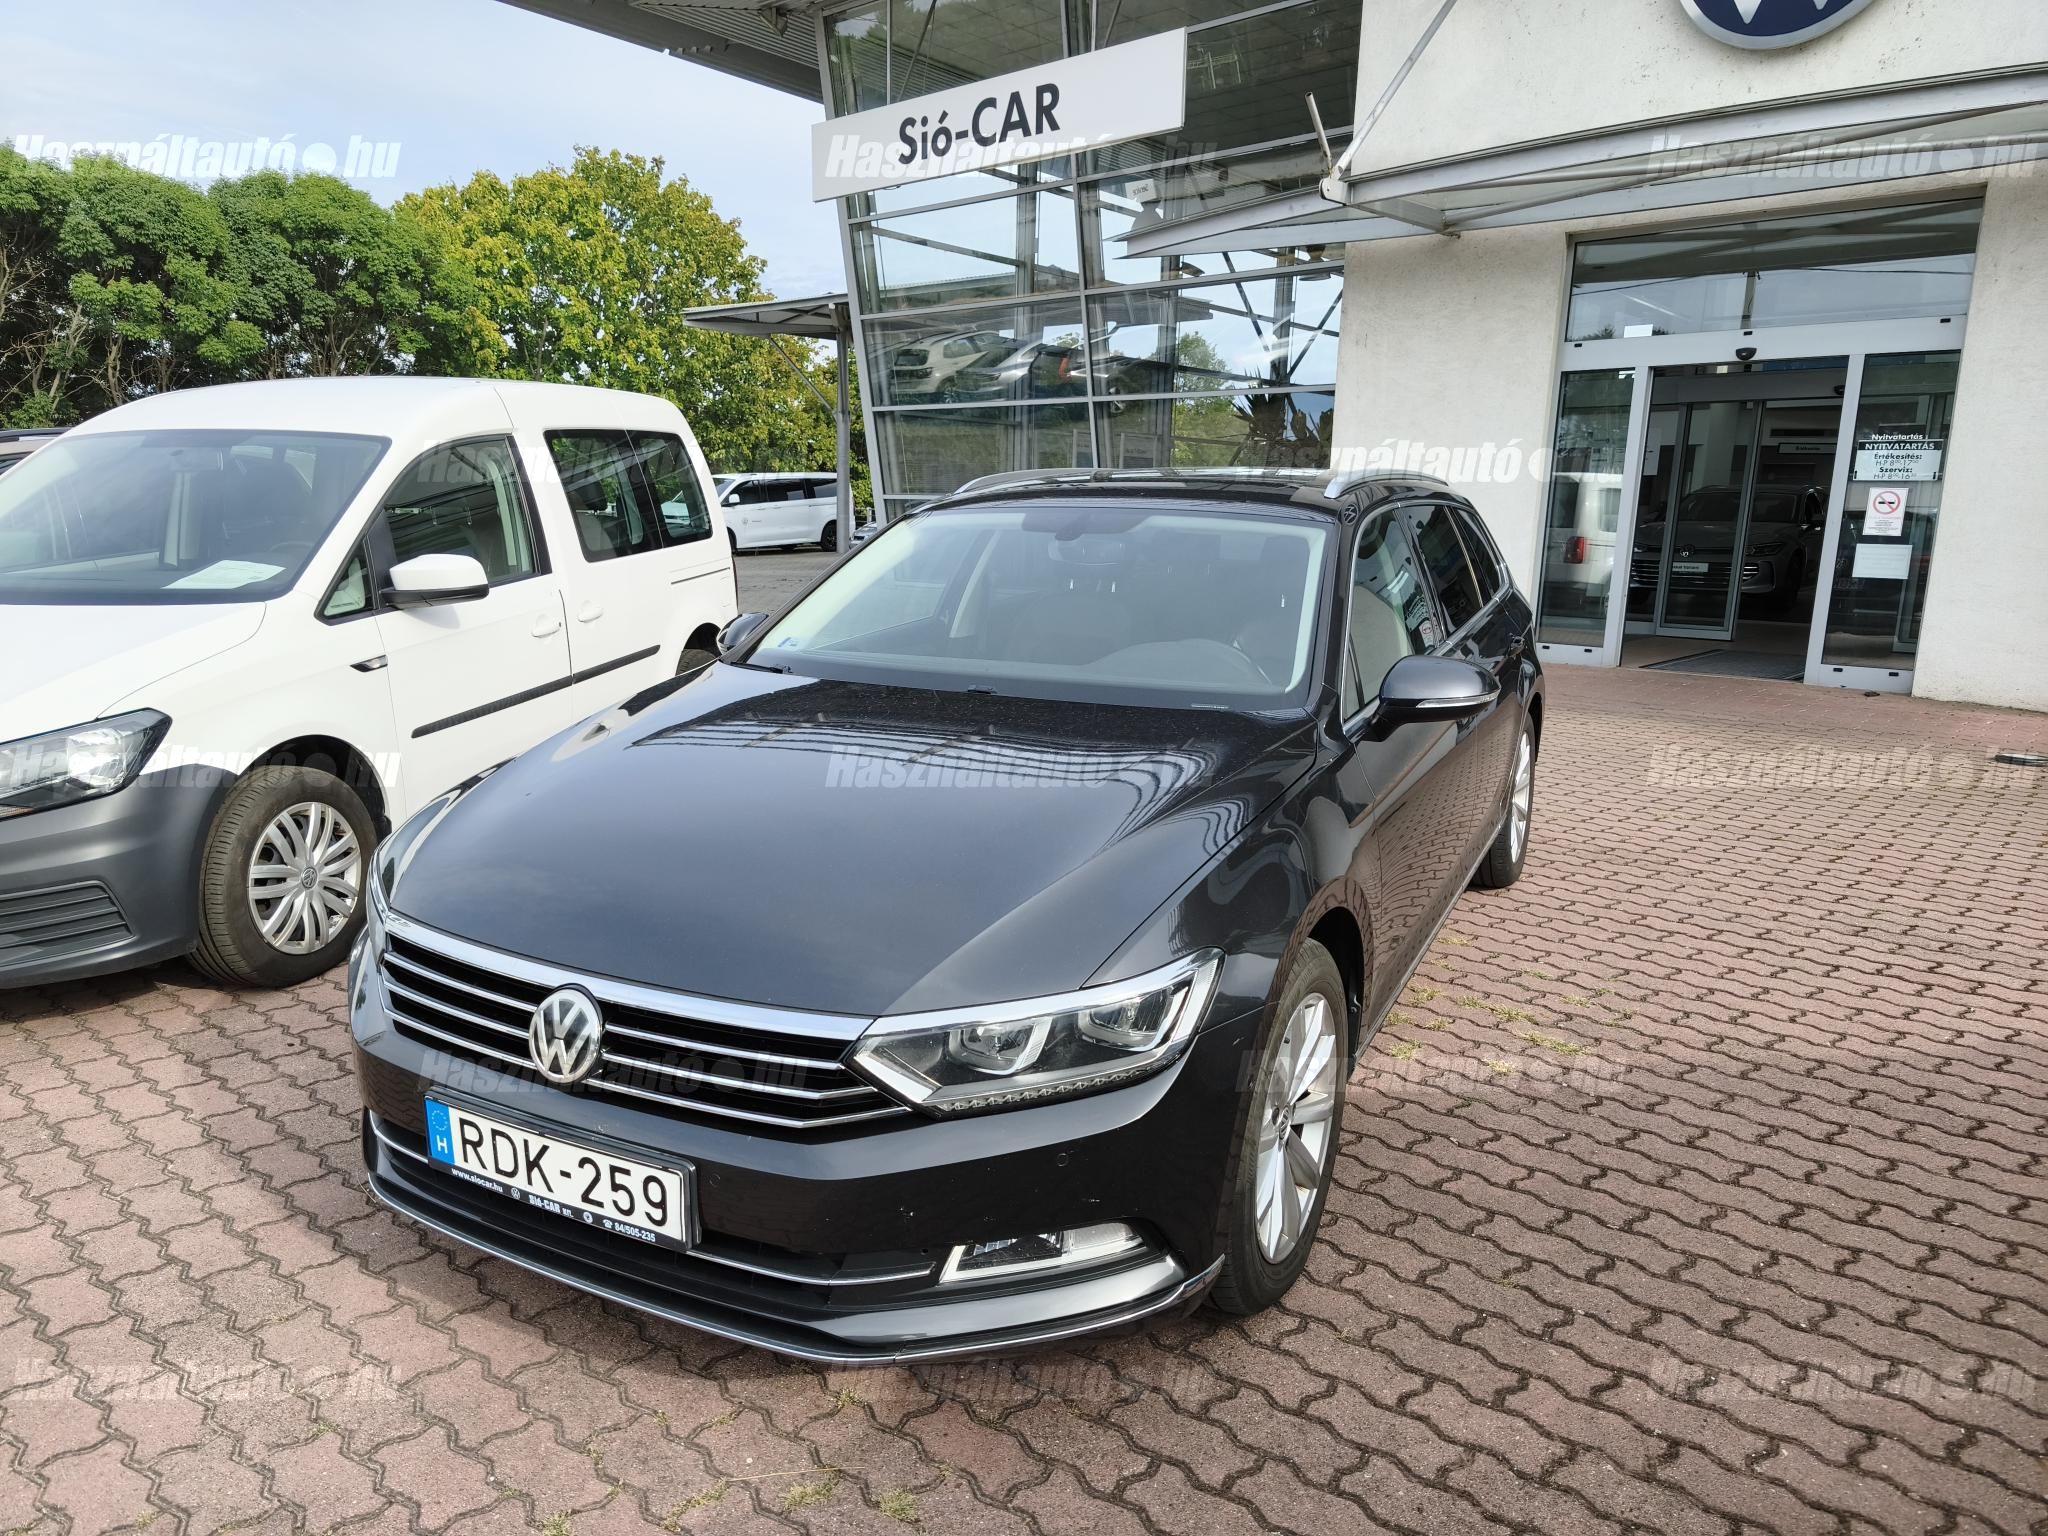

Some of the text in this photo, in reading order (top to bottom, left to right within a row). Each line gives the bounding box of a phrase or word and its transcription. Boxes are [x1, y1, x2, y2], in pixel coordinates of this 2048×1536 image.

[898, 83, 1061, 166] Sió-CAR
[1864, 441, 1935, 450] NYITVATARTÁS
[1874, 451, 1923, 460] Értékesítés:
[436, 1135, 449, 1154] H
[459, 1117, 668, 1227] RDK-259
